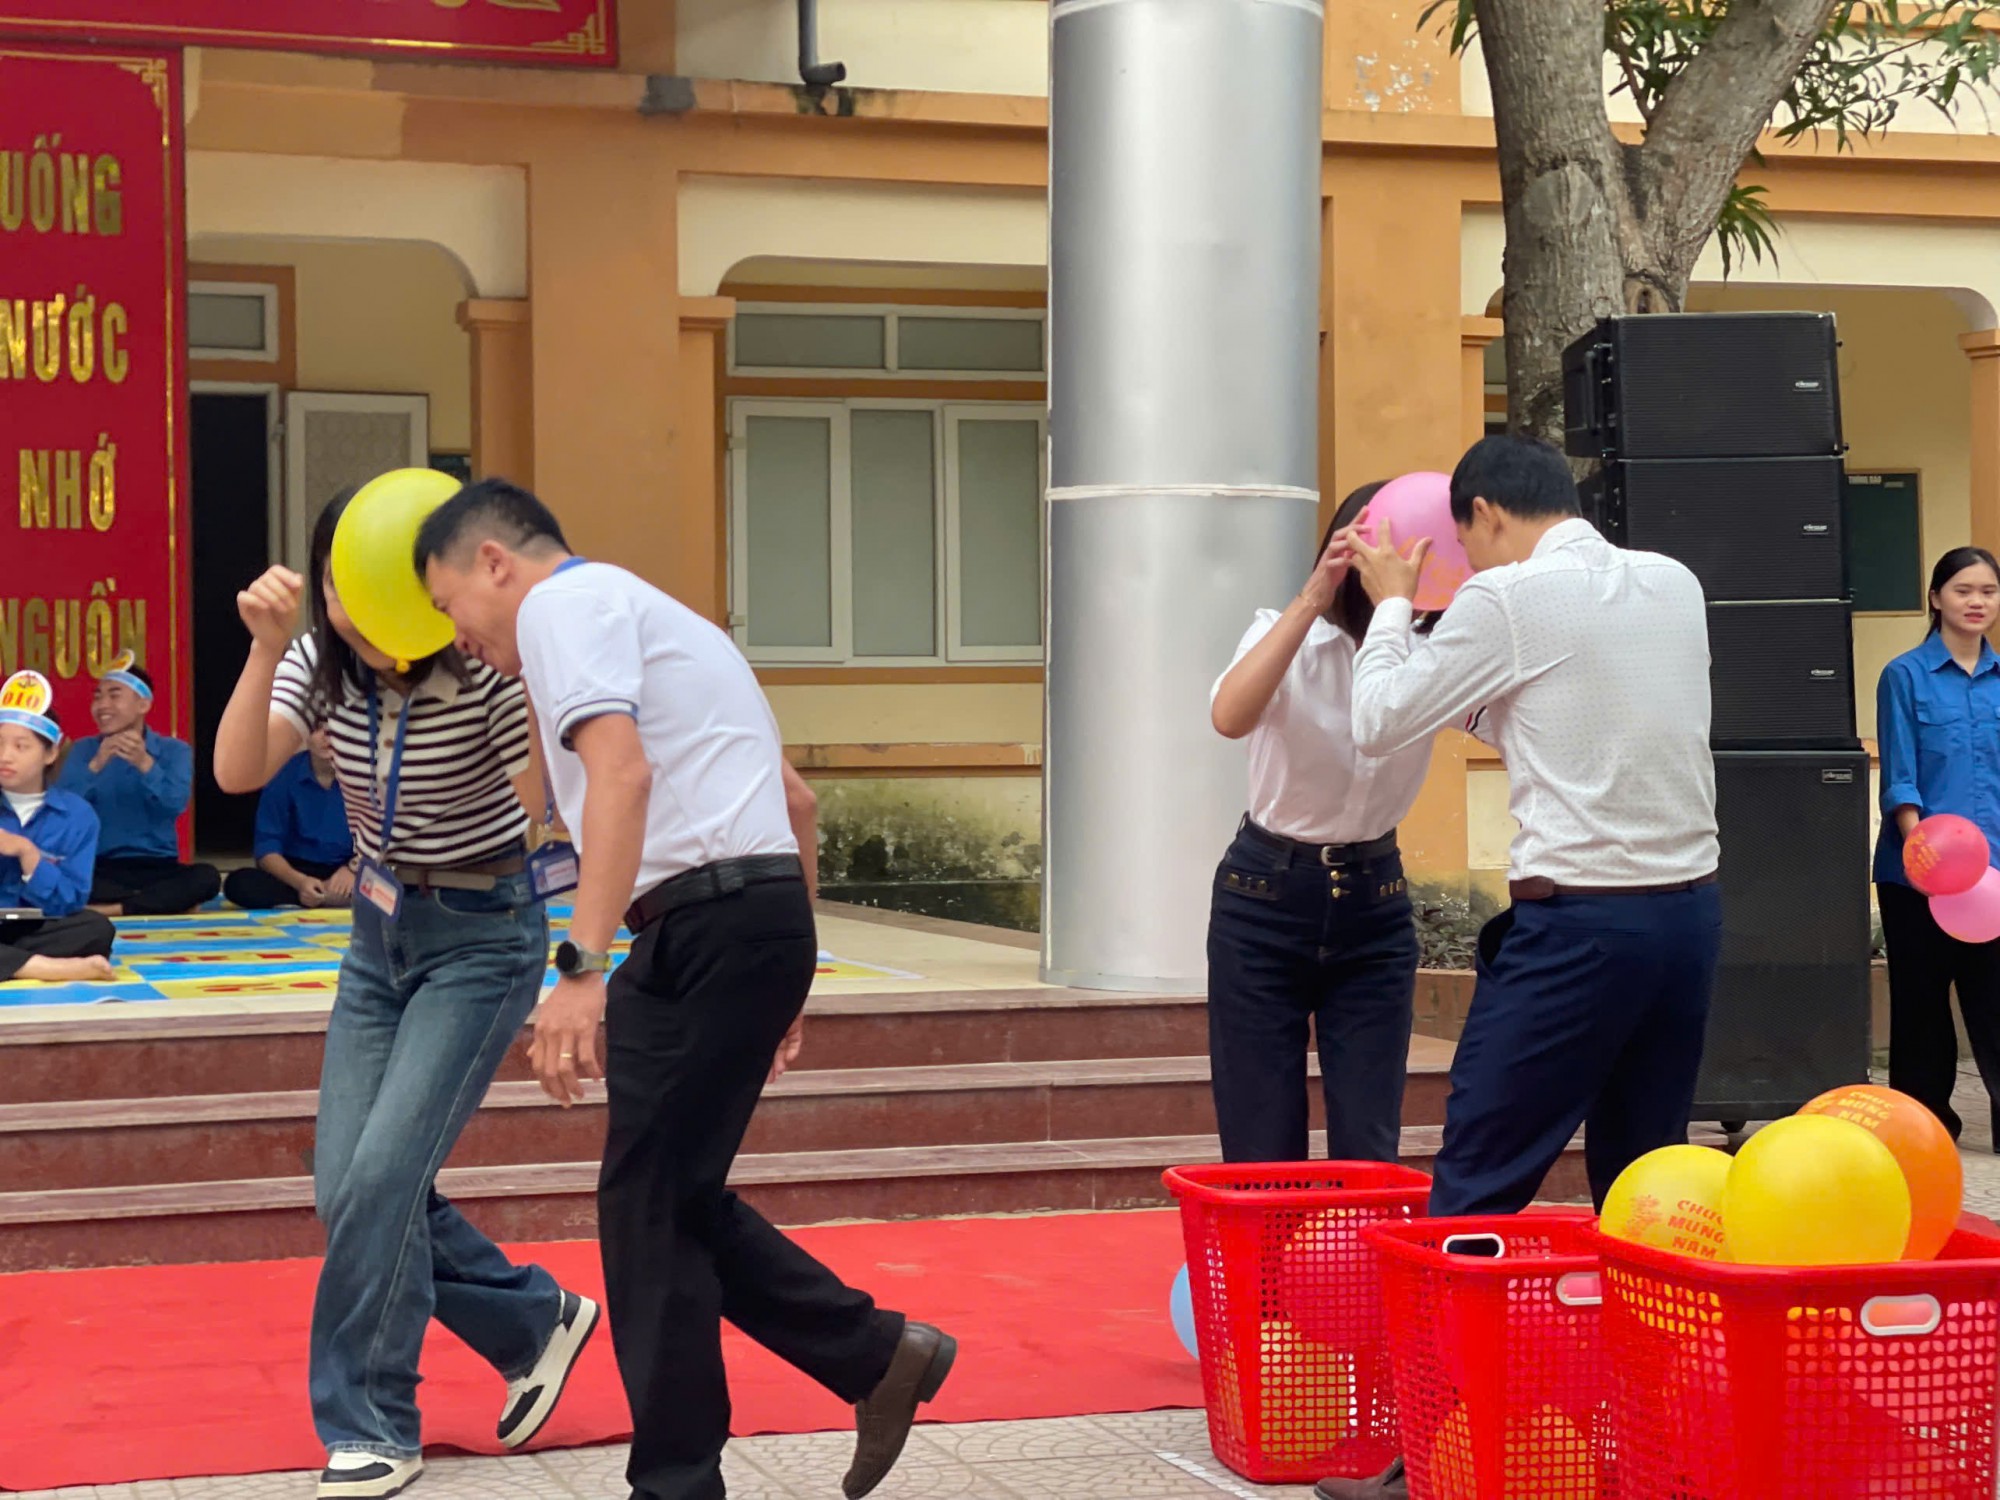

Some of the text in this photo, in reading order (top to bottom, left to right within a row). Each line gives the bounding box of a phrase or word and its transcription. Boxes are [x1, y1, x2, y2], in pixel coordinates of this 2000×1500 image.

[0, 132, 121, 235] UỐNG
[0, 283, 129, 384] NƯỚC
[19, 432, 117, 532] NHỚ
[0, 577, 146, 680] NGUỒN
